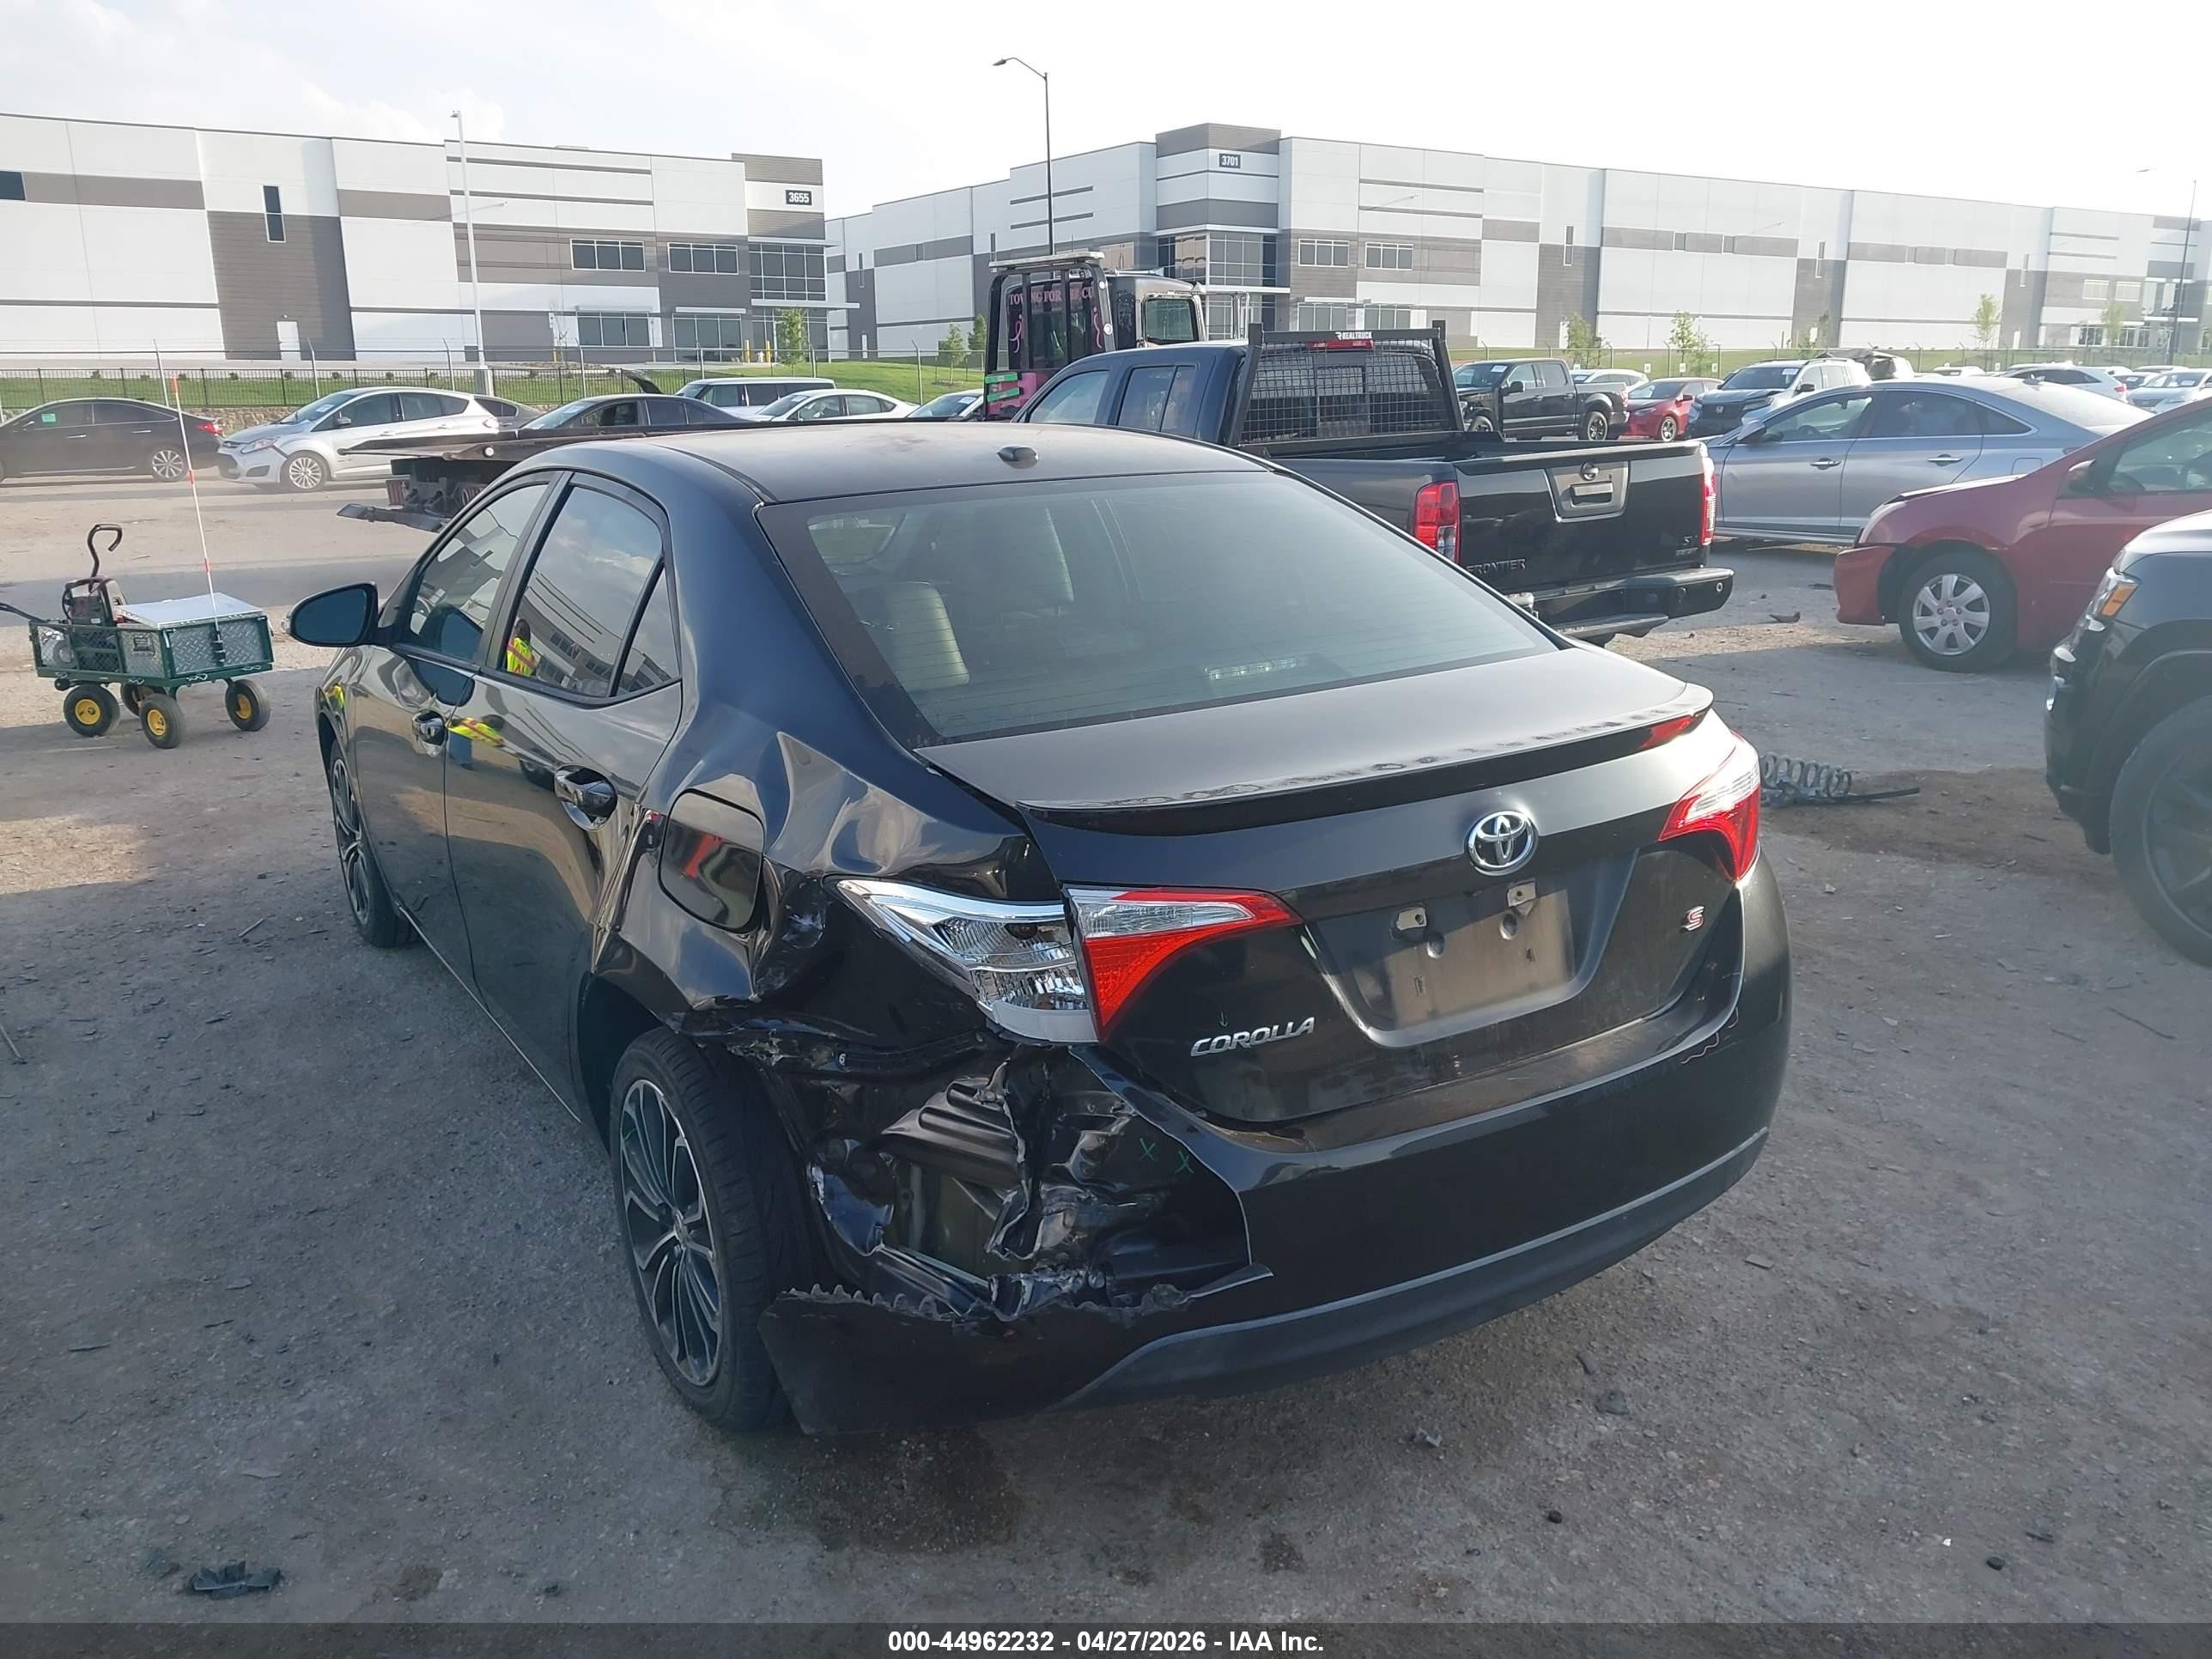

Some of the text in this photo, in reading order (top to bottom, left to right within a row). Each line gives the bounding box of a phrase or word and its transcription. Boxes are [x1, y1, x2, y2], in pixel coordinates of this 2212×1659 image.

[1221, 155, 1238, 167] 3701
[788, 191, 810, 204] 3655
[1043, 290, 1062, 302] FOR
[1684, 906, 1705, 931] S
[1190, 1017, 1315, 1057] COROLLA
